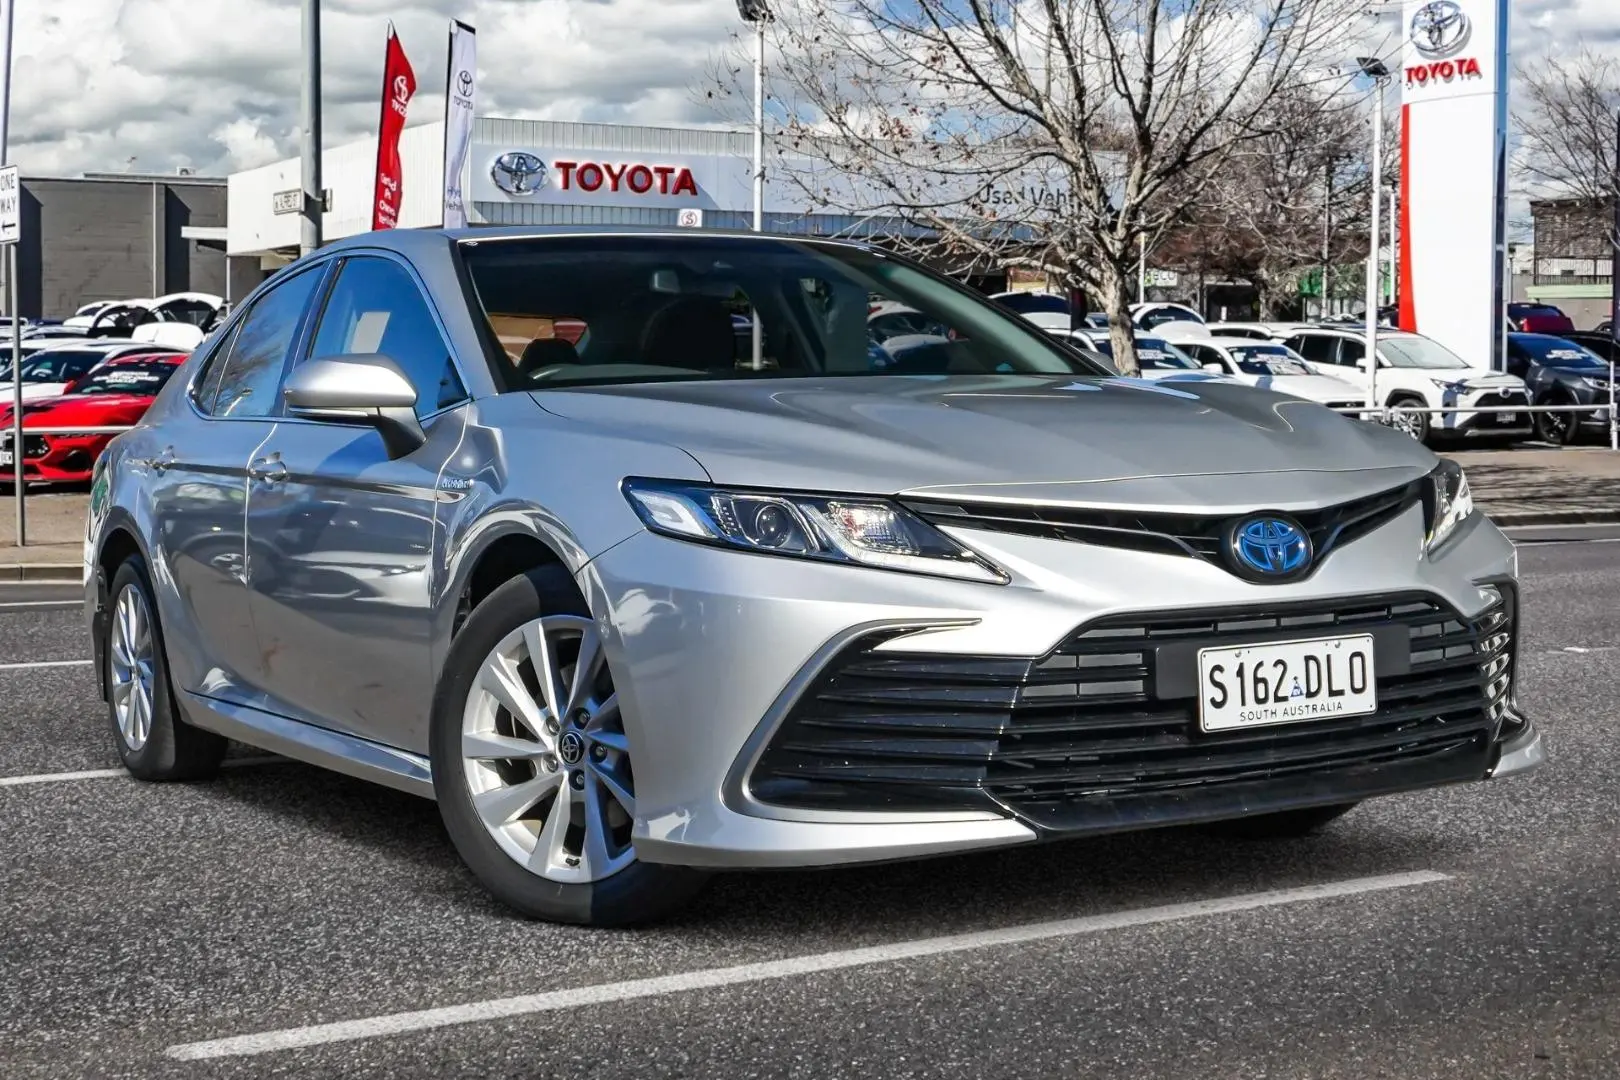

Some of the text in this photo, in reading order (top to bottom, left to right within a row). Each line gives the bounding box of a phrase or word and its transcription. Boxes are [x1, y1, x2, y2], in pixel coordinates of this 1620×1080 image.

[1404, 57, 1479, 83] TOYOTA
[0, 173, 15, 191] ONE
[555, 161, 698, 196] TOYOTA
[1209, 650, 1368, 710] S162 DLO
[1239, 701, 1343, 722] SOUTH AUSTRALIA
